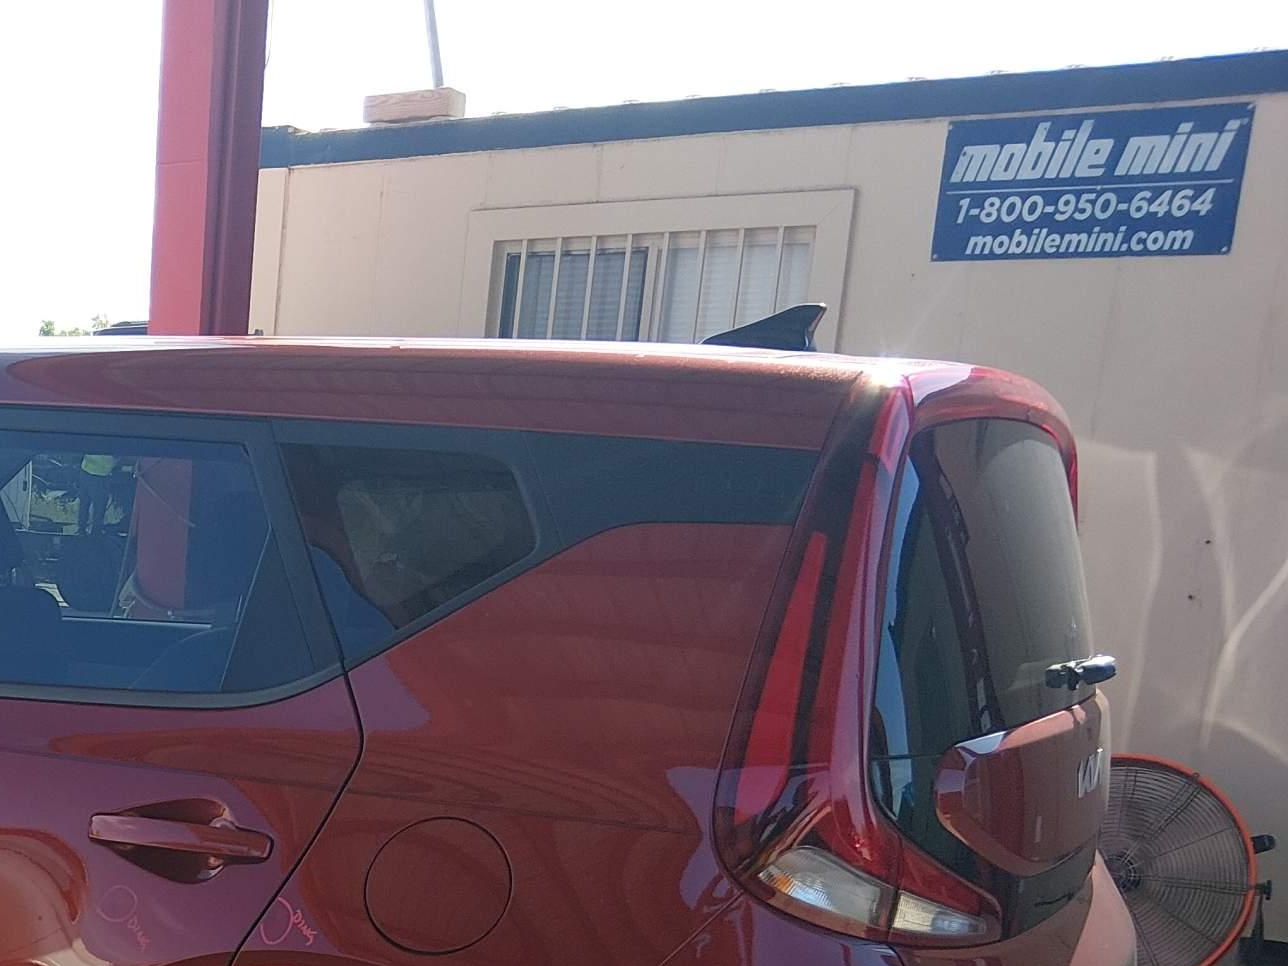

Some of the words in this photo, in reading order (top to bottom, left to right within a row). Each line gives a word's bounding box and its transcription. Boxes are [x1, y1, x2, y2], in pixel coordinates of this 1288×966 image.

[949, 119, 1115, 183] mobile
[1114, 118, 1241, 176] mini
[956, 187, 1216, 225] 1-800-950-6464
[964, 226, 1194, 255] mobilemini.com
